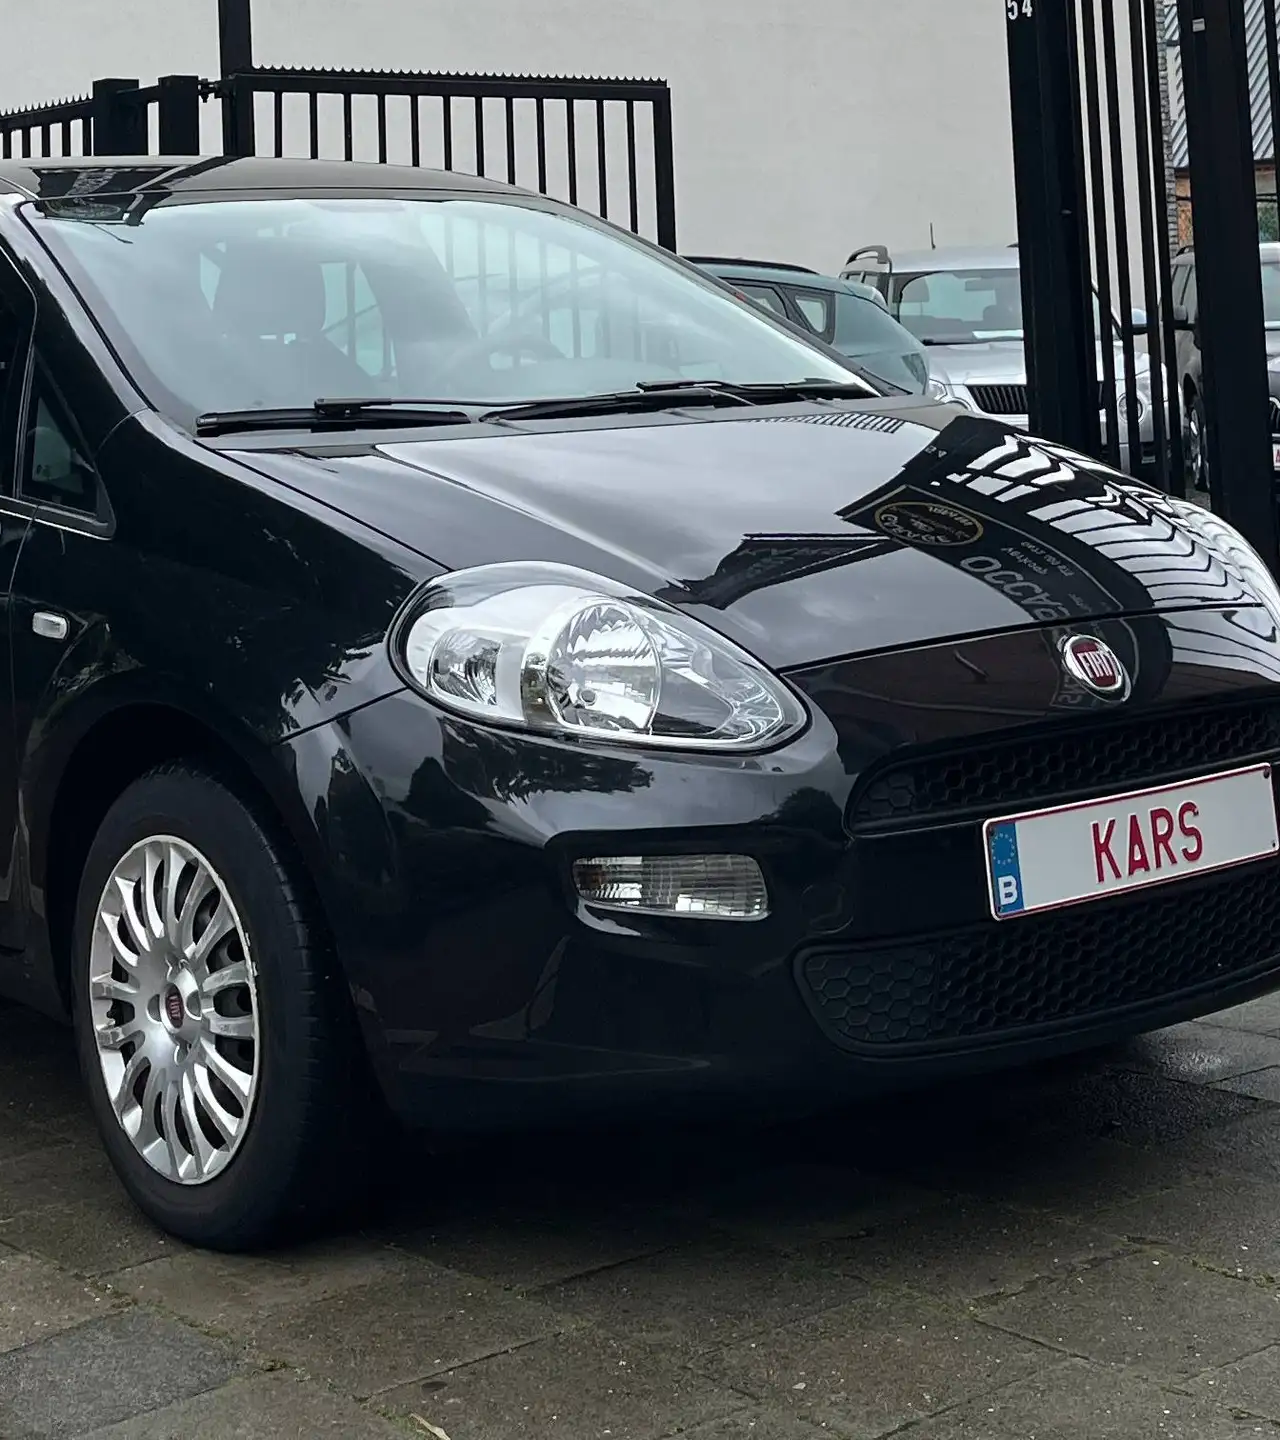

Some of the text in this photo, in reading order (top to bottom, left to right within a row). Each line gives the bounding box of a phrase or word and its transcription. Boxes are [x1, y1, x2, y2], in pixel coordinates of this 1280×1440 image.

[1077, 651, 1113, 679] FIAT
[1090, 801, 1204, 884] KARS
[998, 875, 1019, 906] B
